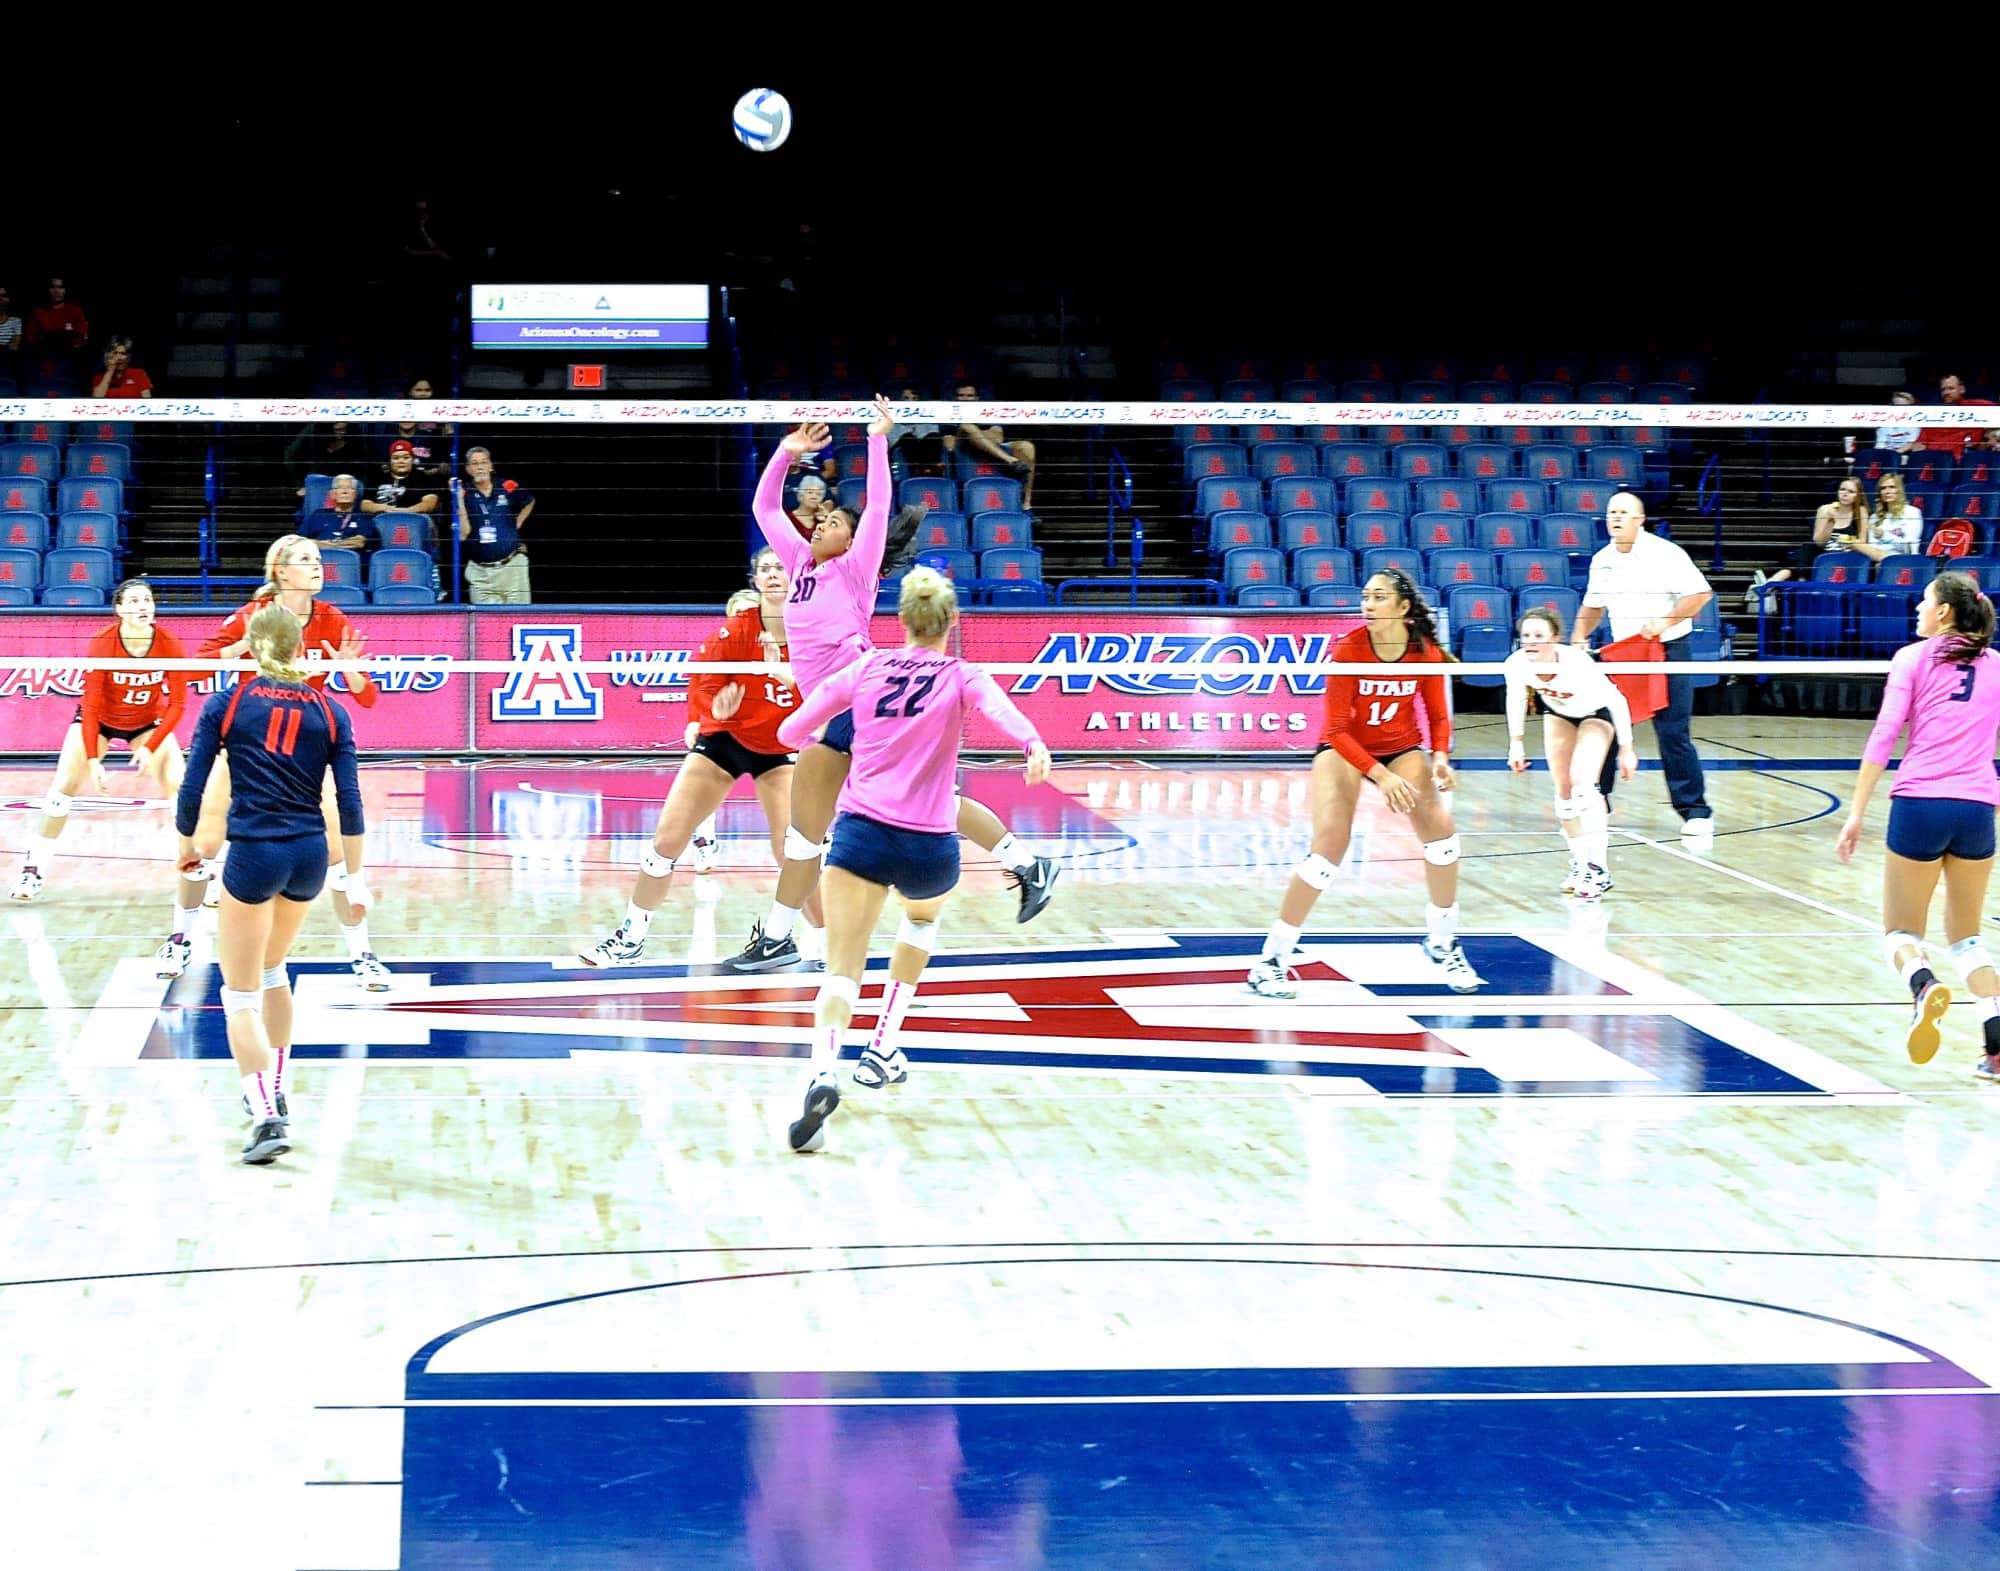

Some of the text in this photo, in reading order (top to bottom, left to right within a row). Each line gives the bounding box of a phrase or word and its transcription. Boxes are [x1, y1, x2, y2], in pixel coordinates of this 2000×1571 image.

[491, 623, 605, 721] A
[610, 649, 691, 687] WIL
[1009, 631, 1334, 696] ARIZON
[112, 670, 166, 687] UTAH
[1358, 678, 1419, 697] UTAH
[1950, 663, 1976, 703] 3
[121, 688, 152, 705] 19
[249, 684, 321, 703] ARIZONA
[763, 682, 795, 708] 12
[874, 673, 937, 718] 22
[1085, 711, 1308, 732] ATHLETICS
[1365, 700, 1401, 726] 14
[264, 706, 303, 757] 11
